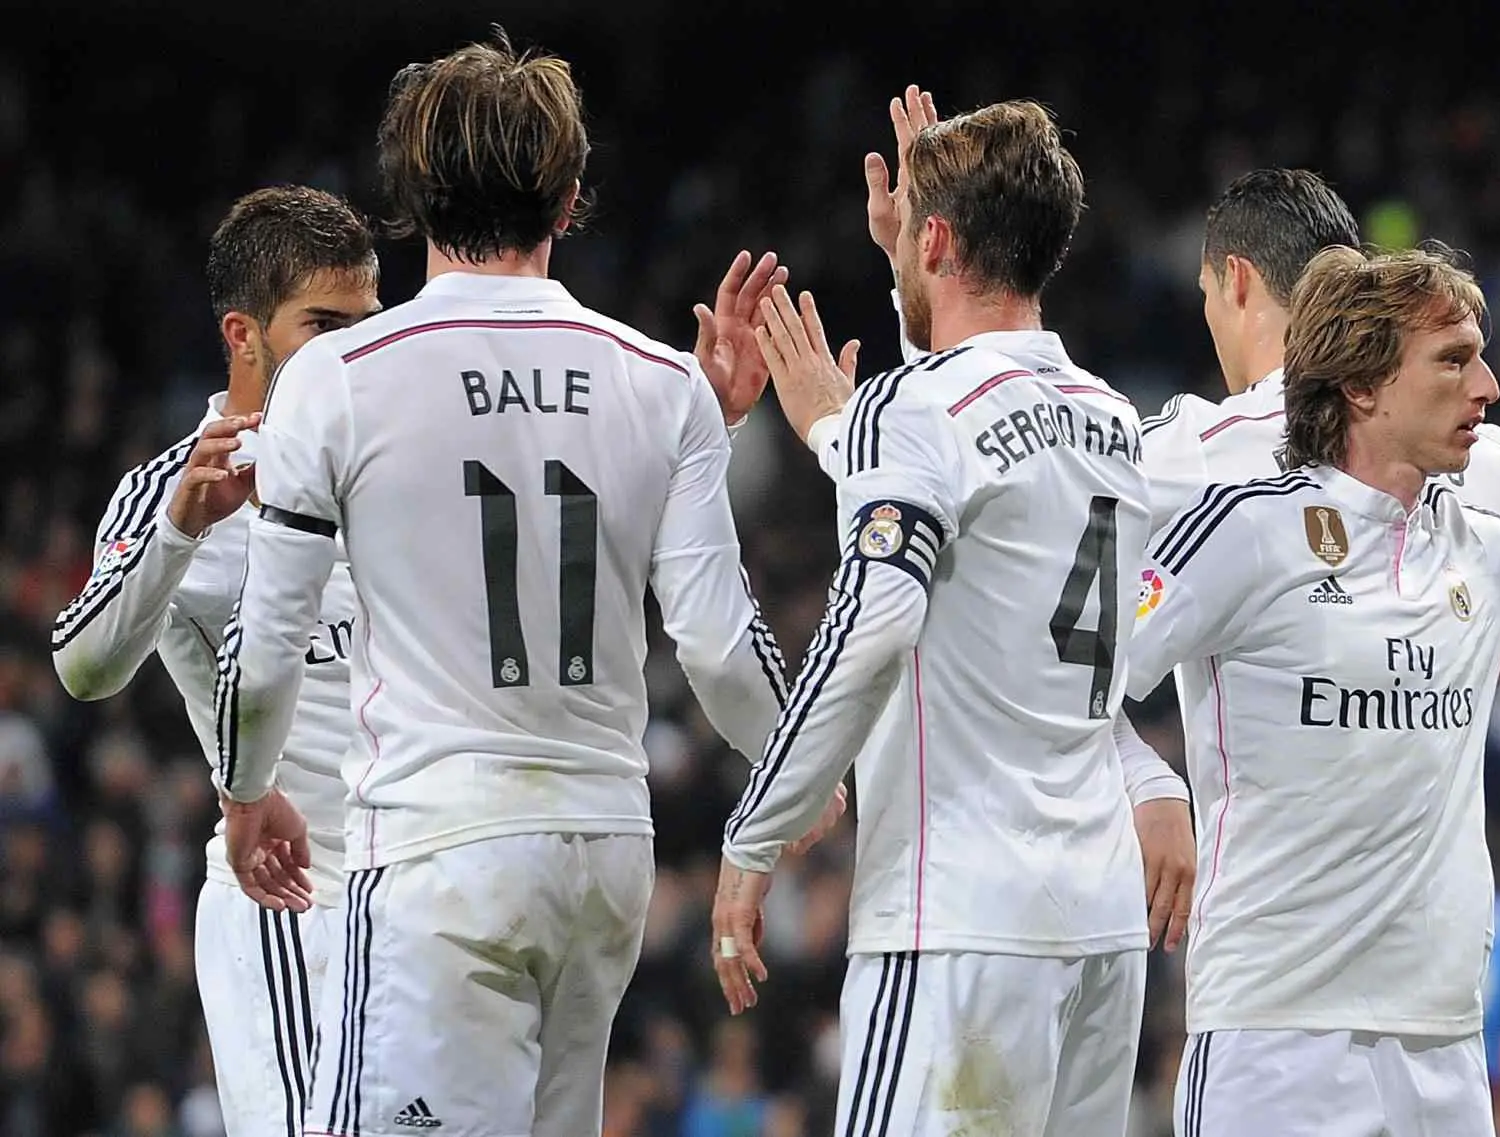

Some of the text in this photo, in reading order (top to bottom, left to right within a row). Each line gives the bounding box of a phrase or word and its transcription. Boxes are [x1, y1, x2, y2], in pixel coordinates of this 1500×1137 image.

[461, 369, 590, 416] BALE
[976, 403, 1076, 474] SERGIO
[463, 460, 598, 689] 11
[1308, 592, 1353, 605] adidas
[1049, 495, 1119, 719] 4
[1385, 637, 1434, 680] Fly
[1300, 676, 1473, 730] Emirates
[394, 1116, 442, 1127] adidas
